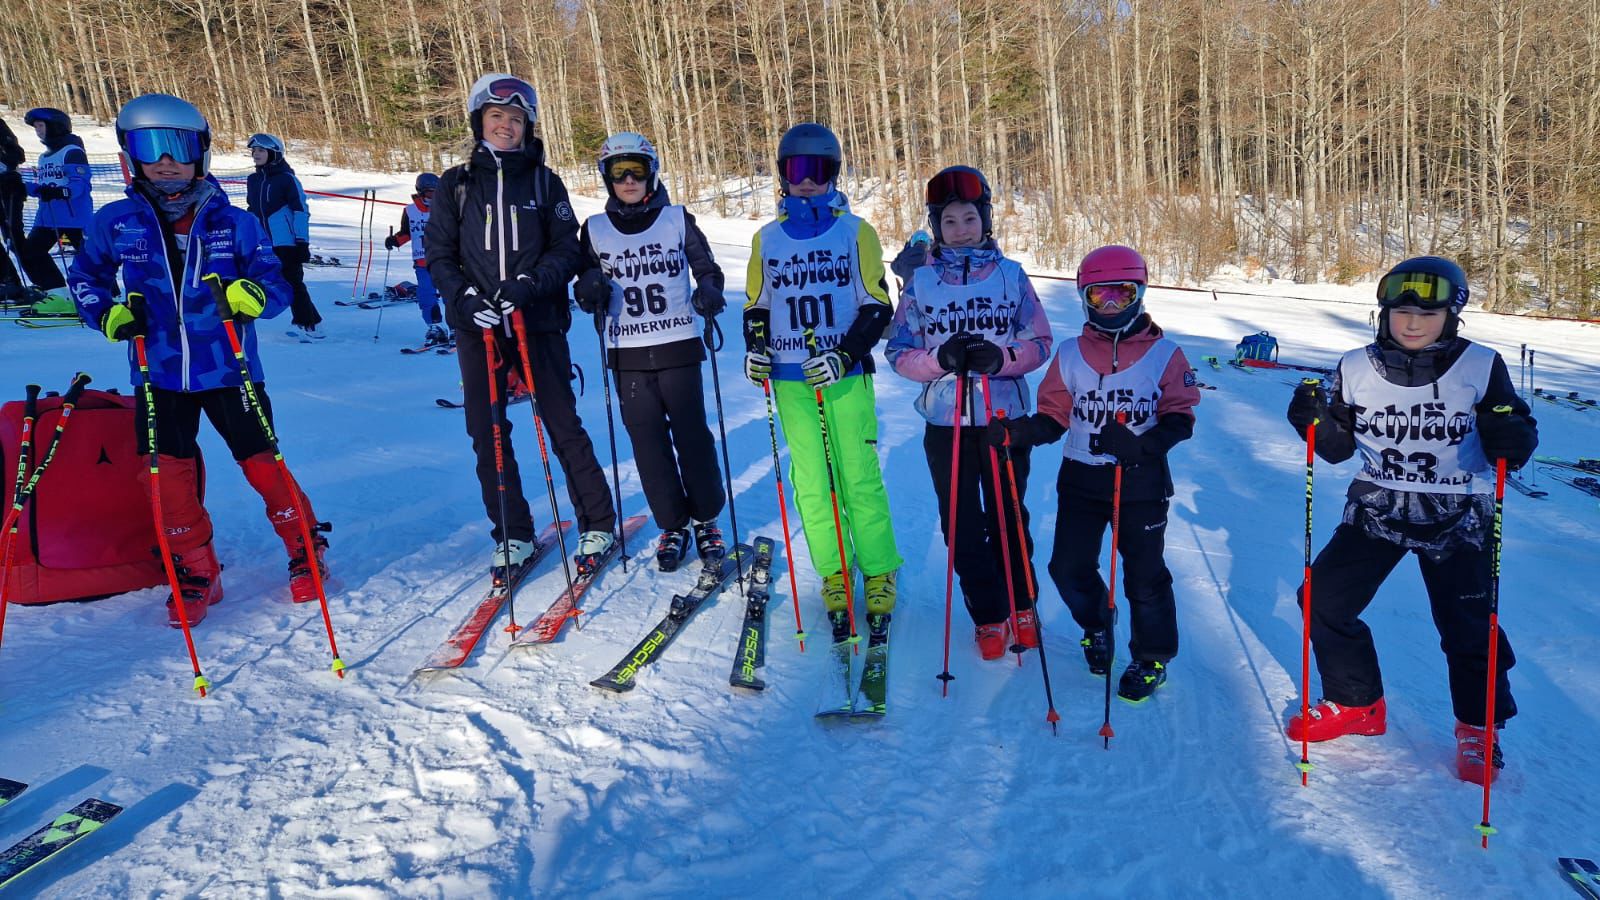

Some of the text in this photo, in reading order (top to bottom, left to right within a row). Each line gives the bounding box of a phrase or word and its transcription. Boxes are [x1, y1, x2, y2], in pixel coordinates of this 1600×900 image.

[623, 283, 668, 318] 96
[785, 293, 835, 331] 101
[17, 454, 28, 483] LEKI
[23, 466, 45, 494] LEKI
[1380, 447, 1439, 479] 63
[1494, 502, 1503, 539] LEKI
[615, 630, 665, 685] FISCHER
[742, 627, 759, 683] FISCHER
